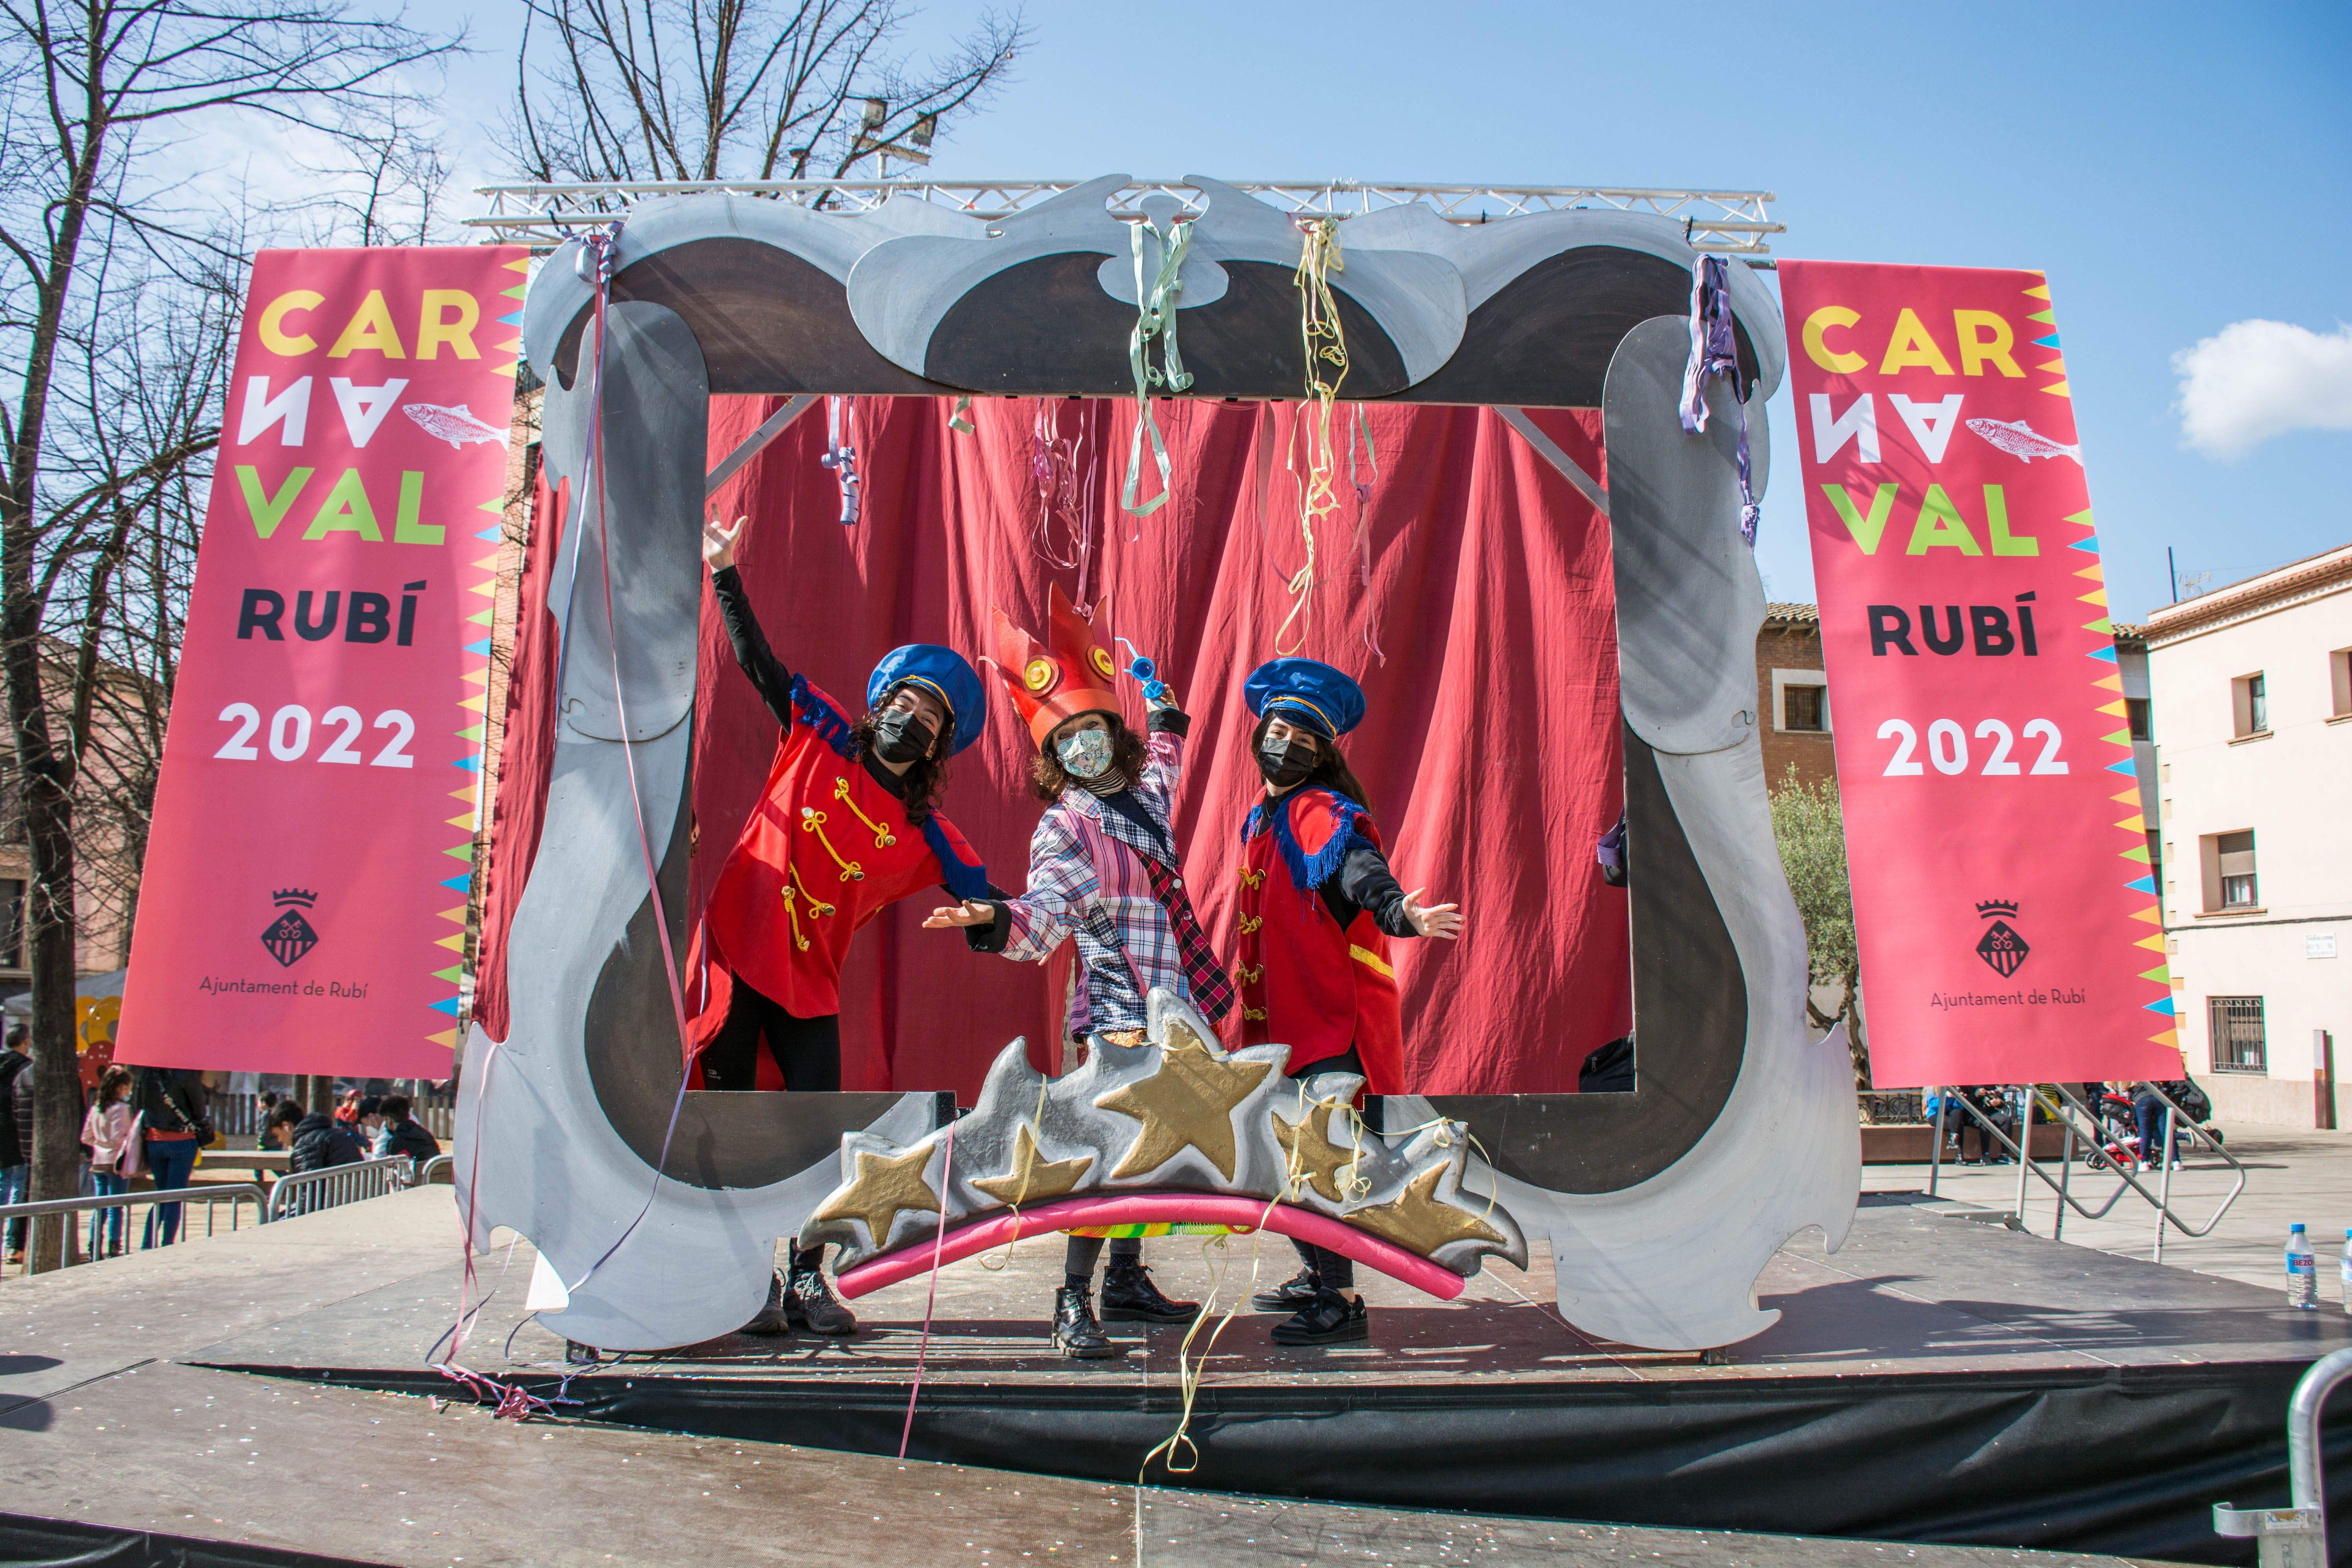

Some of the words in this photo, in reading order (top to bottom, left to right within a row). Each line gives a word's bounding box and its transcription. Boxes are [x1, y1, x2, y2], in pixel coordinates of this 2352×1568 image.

[258, 289, 481, 360] CAR
[1802, 306, 2026, 378] CAR
[234, 465, 445, 545] VAL
[1821, 483, 2040, 557] VAL
[237, 580, 426, 646] RUBÍ
[1867, 590, 2038, 657] RUBÍ
[214, 702, 415, 768] 2022
[1877, 719, 2069, 776] 2022
[199, 976, 298, 995] Ajuntament
[303, 979, 324, 996] de
[329, 981, 368, 998] Rubí
[1931, 991, 2024, 1011] Ajuntament
[2028, 988, 2047, 1004] de
[2051, 988, 2086, 1004] Rubí
